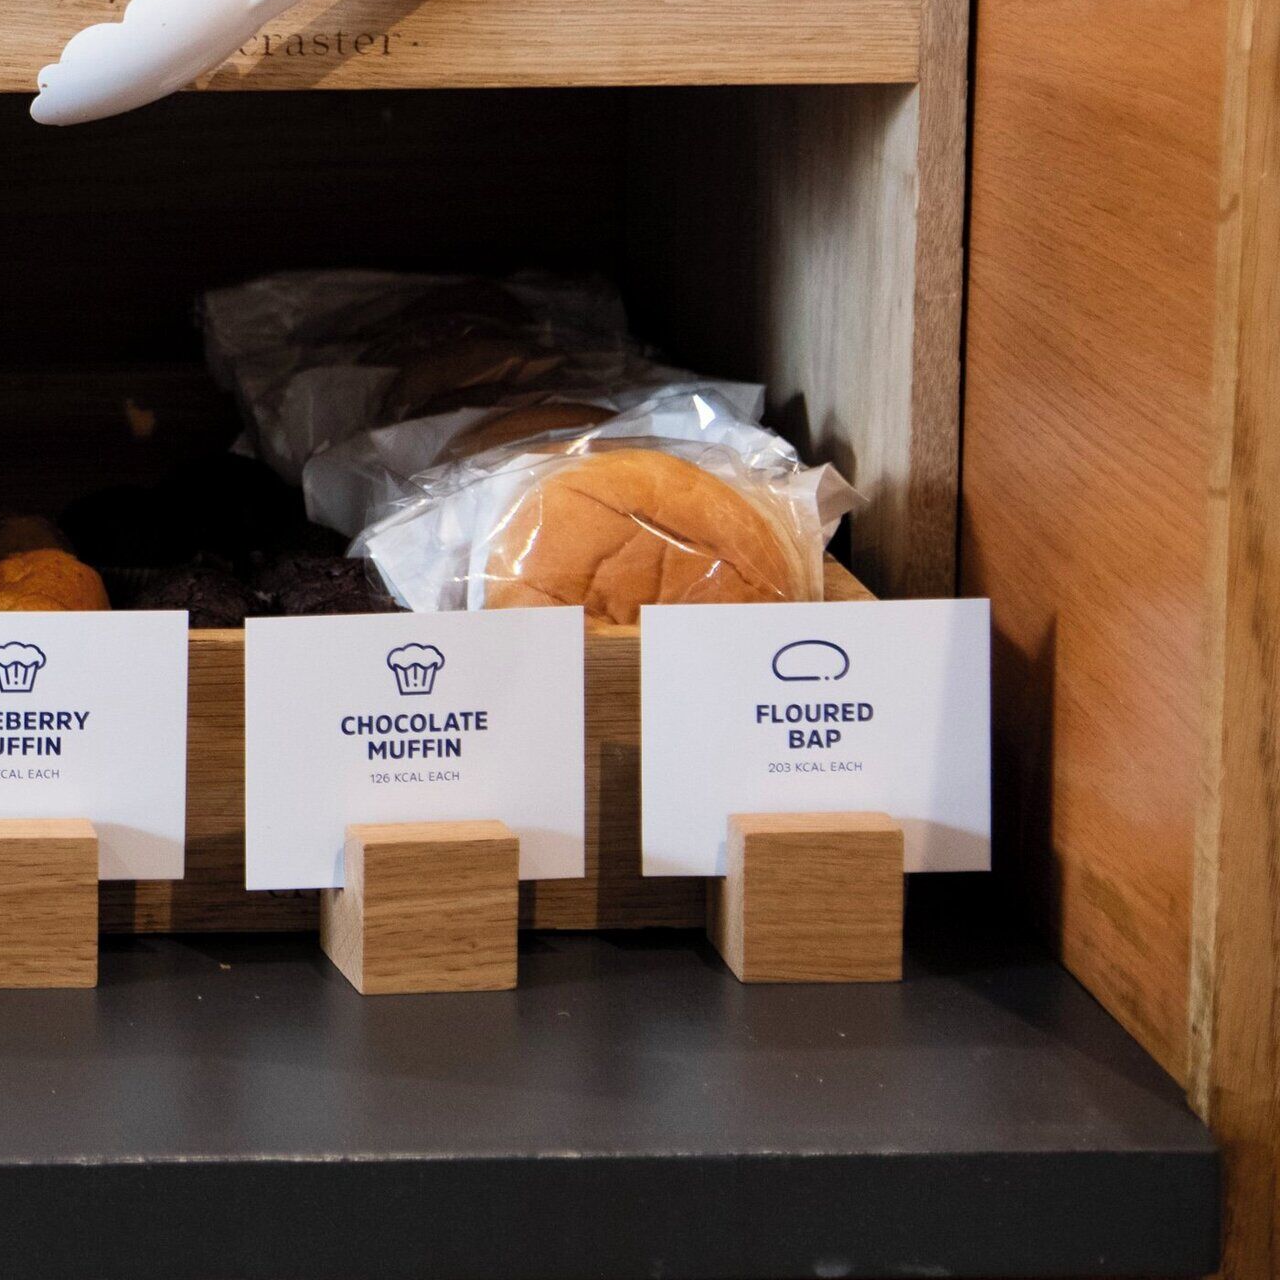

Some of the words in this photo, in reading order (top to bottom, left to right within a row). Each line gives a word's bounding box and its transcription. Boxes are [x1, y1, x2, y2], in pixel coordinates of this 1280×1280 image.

[340, 711, 488, 736] CHOCOLATE
[756, 703, 874, 724] FLOURED
[368, 738, 462, 760] MUFFIN
[788, 729, 842, 749] BAP
[28, 769, 60, 780] EACH
[768, 762, 791, 773] 203
[795, 762, 826, 773] KCAL
[830, 761, 863, 772] EACH
[369, 773, 391, 784] 126
[394, 772, 425, 783] KCAL
[428, 771, 460, 782] EACH
